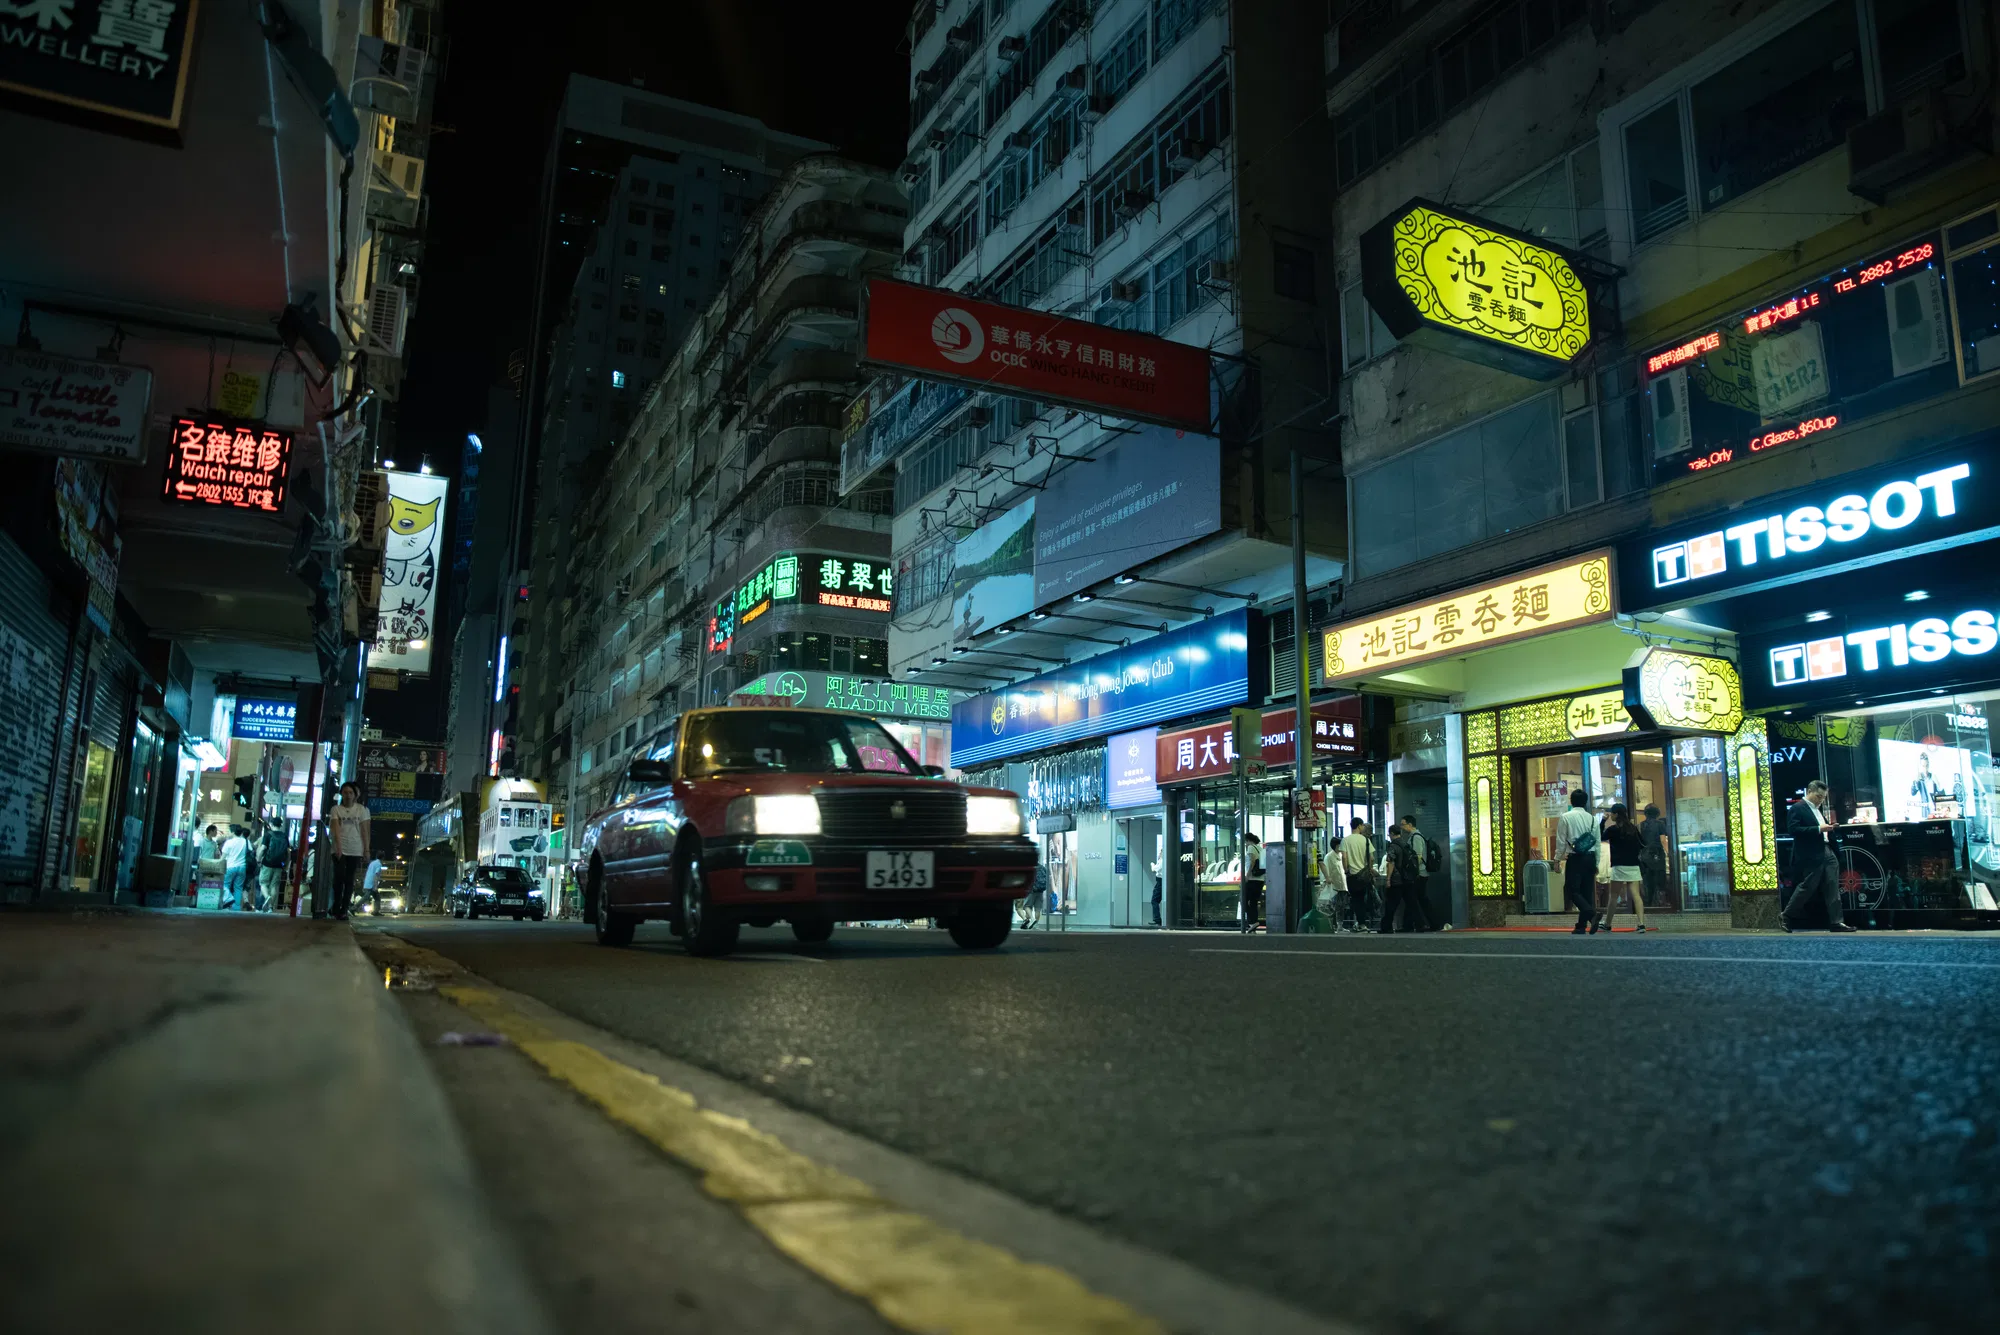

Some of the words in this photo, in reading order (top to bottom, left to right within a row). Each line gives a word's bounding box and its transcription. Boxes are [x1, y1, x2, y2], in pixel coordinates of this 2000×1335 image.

[1446, 247, 1543, 310] 池記
[1834, 278, 1856, 294] TEL
[1860, 261, 1894, 284] 2882
[1897, 244, 1933, 269] 2528
[1467, 291, 1527, 326] 雲吞麵
[991, 324, 1155, 378] 華僑永亨信用財務
[990, 350, 1028, 369] OCBC
[1030, 359, 1069, 377] WING
[1071, 367, 1109, 385] HANG
[1113, 375, 1156, 394] CREDIT
[50, 375, 118, 407] Little
[28, 392, 120, 427] Tomato
[62, 424, 135, 444] Restaurant
[180, 459, 226, 482] Watch
[229, 469, 273, 488] repair
[196, 482, 222, 500] 2802
[1039, 528, 1054, 543] Enjoy
[1060, 514, 1077, 532] world
[1084, 497, 1111, 519] exclusive
[1112, 480, 1144, 507] privileges
[1725, 463, 1970, 566] TISSOT
[1361, 584, 1550, 662] 池記雲吞麵
[1847, 609, 2000, 671] TISS
[1078, 683, 1098, 700] Hong
[1121, 668, 1151, 693] Jockey
[1152, 656, 1174, 679] Club
[1674, 675, 1717, 702] 池記
[736, 694, 791, 707] TAXI
[825, 696, 895, 713] ALADIN
[904, 703, 949, 719] MESS
[1572, 699, 1629, 730] 池記
[1261, 732, 1286, 748] CHOW
[1315, 720, 1355, 739] 周大福
[772, 843, 785, 855] 4
[887, 852, 915, 868] TX
[873, 869, 928, 887] 5493
